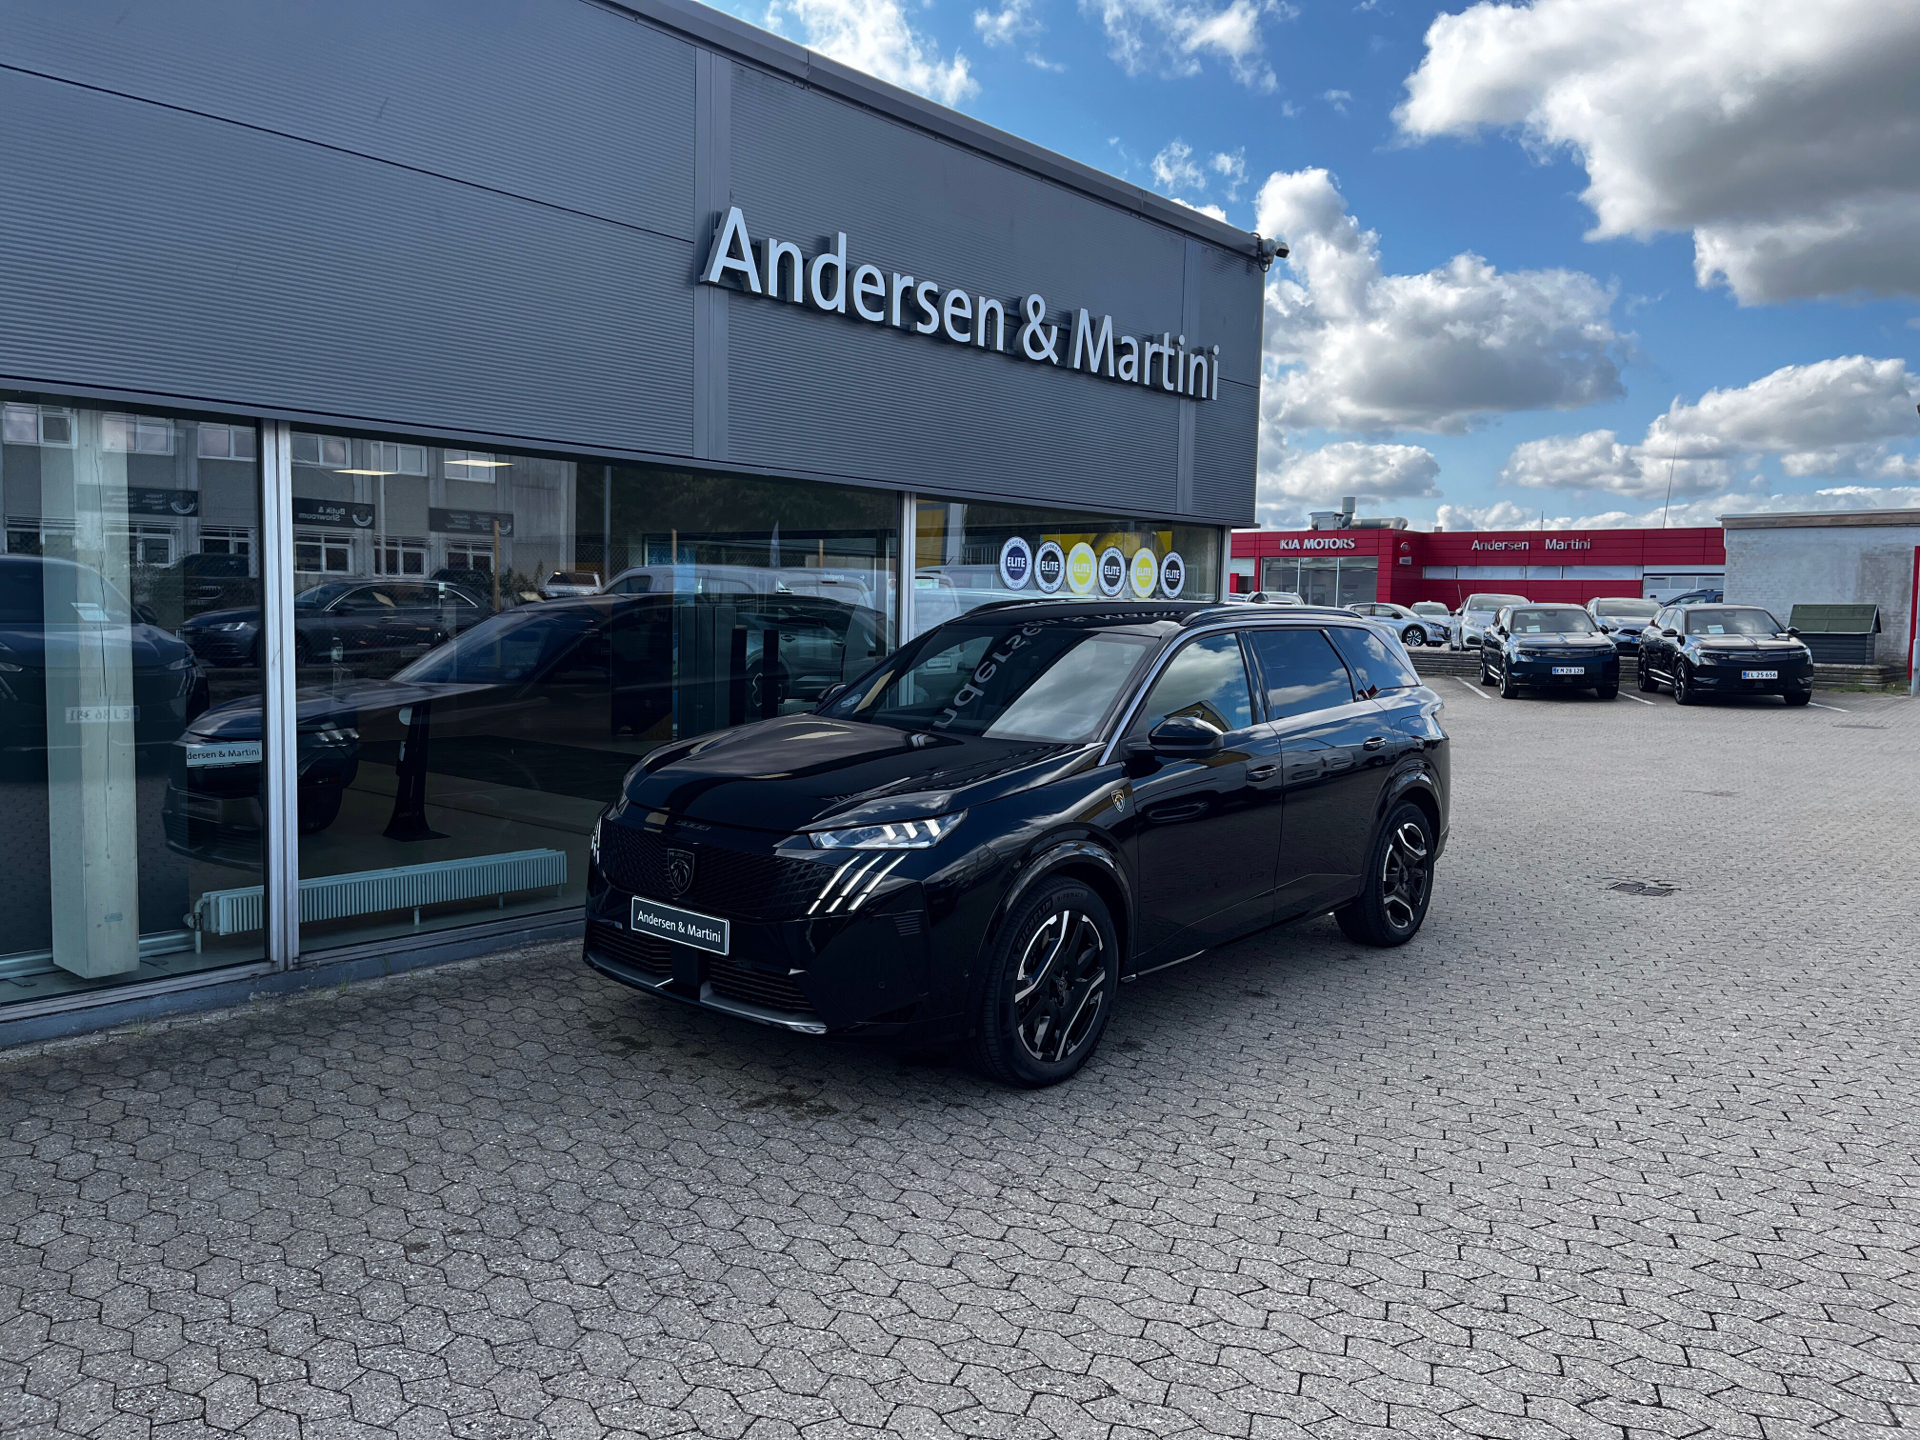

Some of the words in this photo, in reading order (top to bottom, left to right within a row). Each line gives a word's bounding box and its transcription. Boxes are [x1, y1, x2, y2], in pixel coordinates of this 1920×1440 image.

[704, 206, 1006, 351] Andersen
[1016, 293, 1060, 365] &
[1070, 307, 1220, 400] Martini
[1280, 538, 1300, 550] KIA
[1303, 538, 1355, 550] MOTORS
[1471, 540, 1529, 550] Andersen
[1545, 538, 1591, 550] Martini
[1007, 556, 1026, 568] ELITE
[1041, 560, 1059, 572] ELITE
[1074, 562, 1090, 573] ELITE
[1104, 566, 1120, 576] ELITE
[1136, 566, 1152, 576] ELITE
[1166, 569, 1180, 580] ELITE
[187, 752, 216, 760] dersen
[218, 750, 226, 758] &
[228, 748, 260, 757] Martini
[668, 852, 692, 860] PEUGEOT
[637, 910, 676, 931] Andersen
[678, 921, 686, 934] &
[687, 924, 721, 943] Martini
[1017, 900, 1052, 951] MICHELIN
